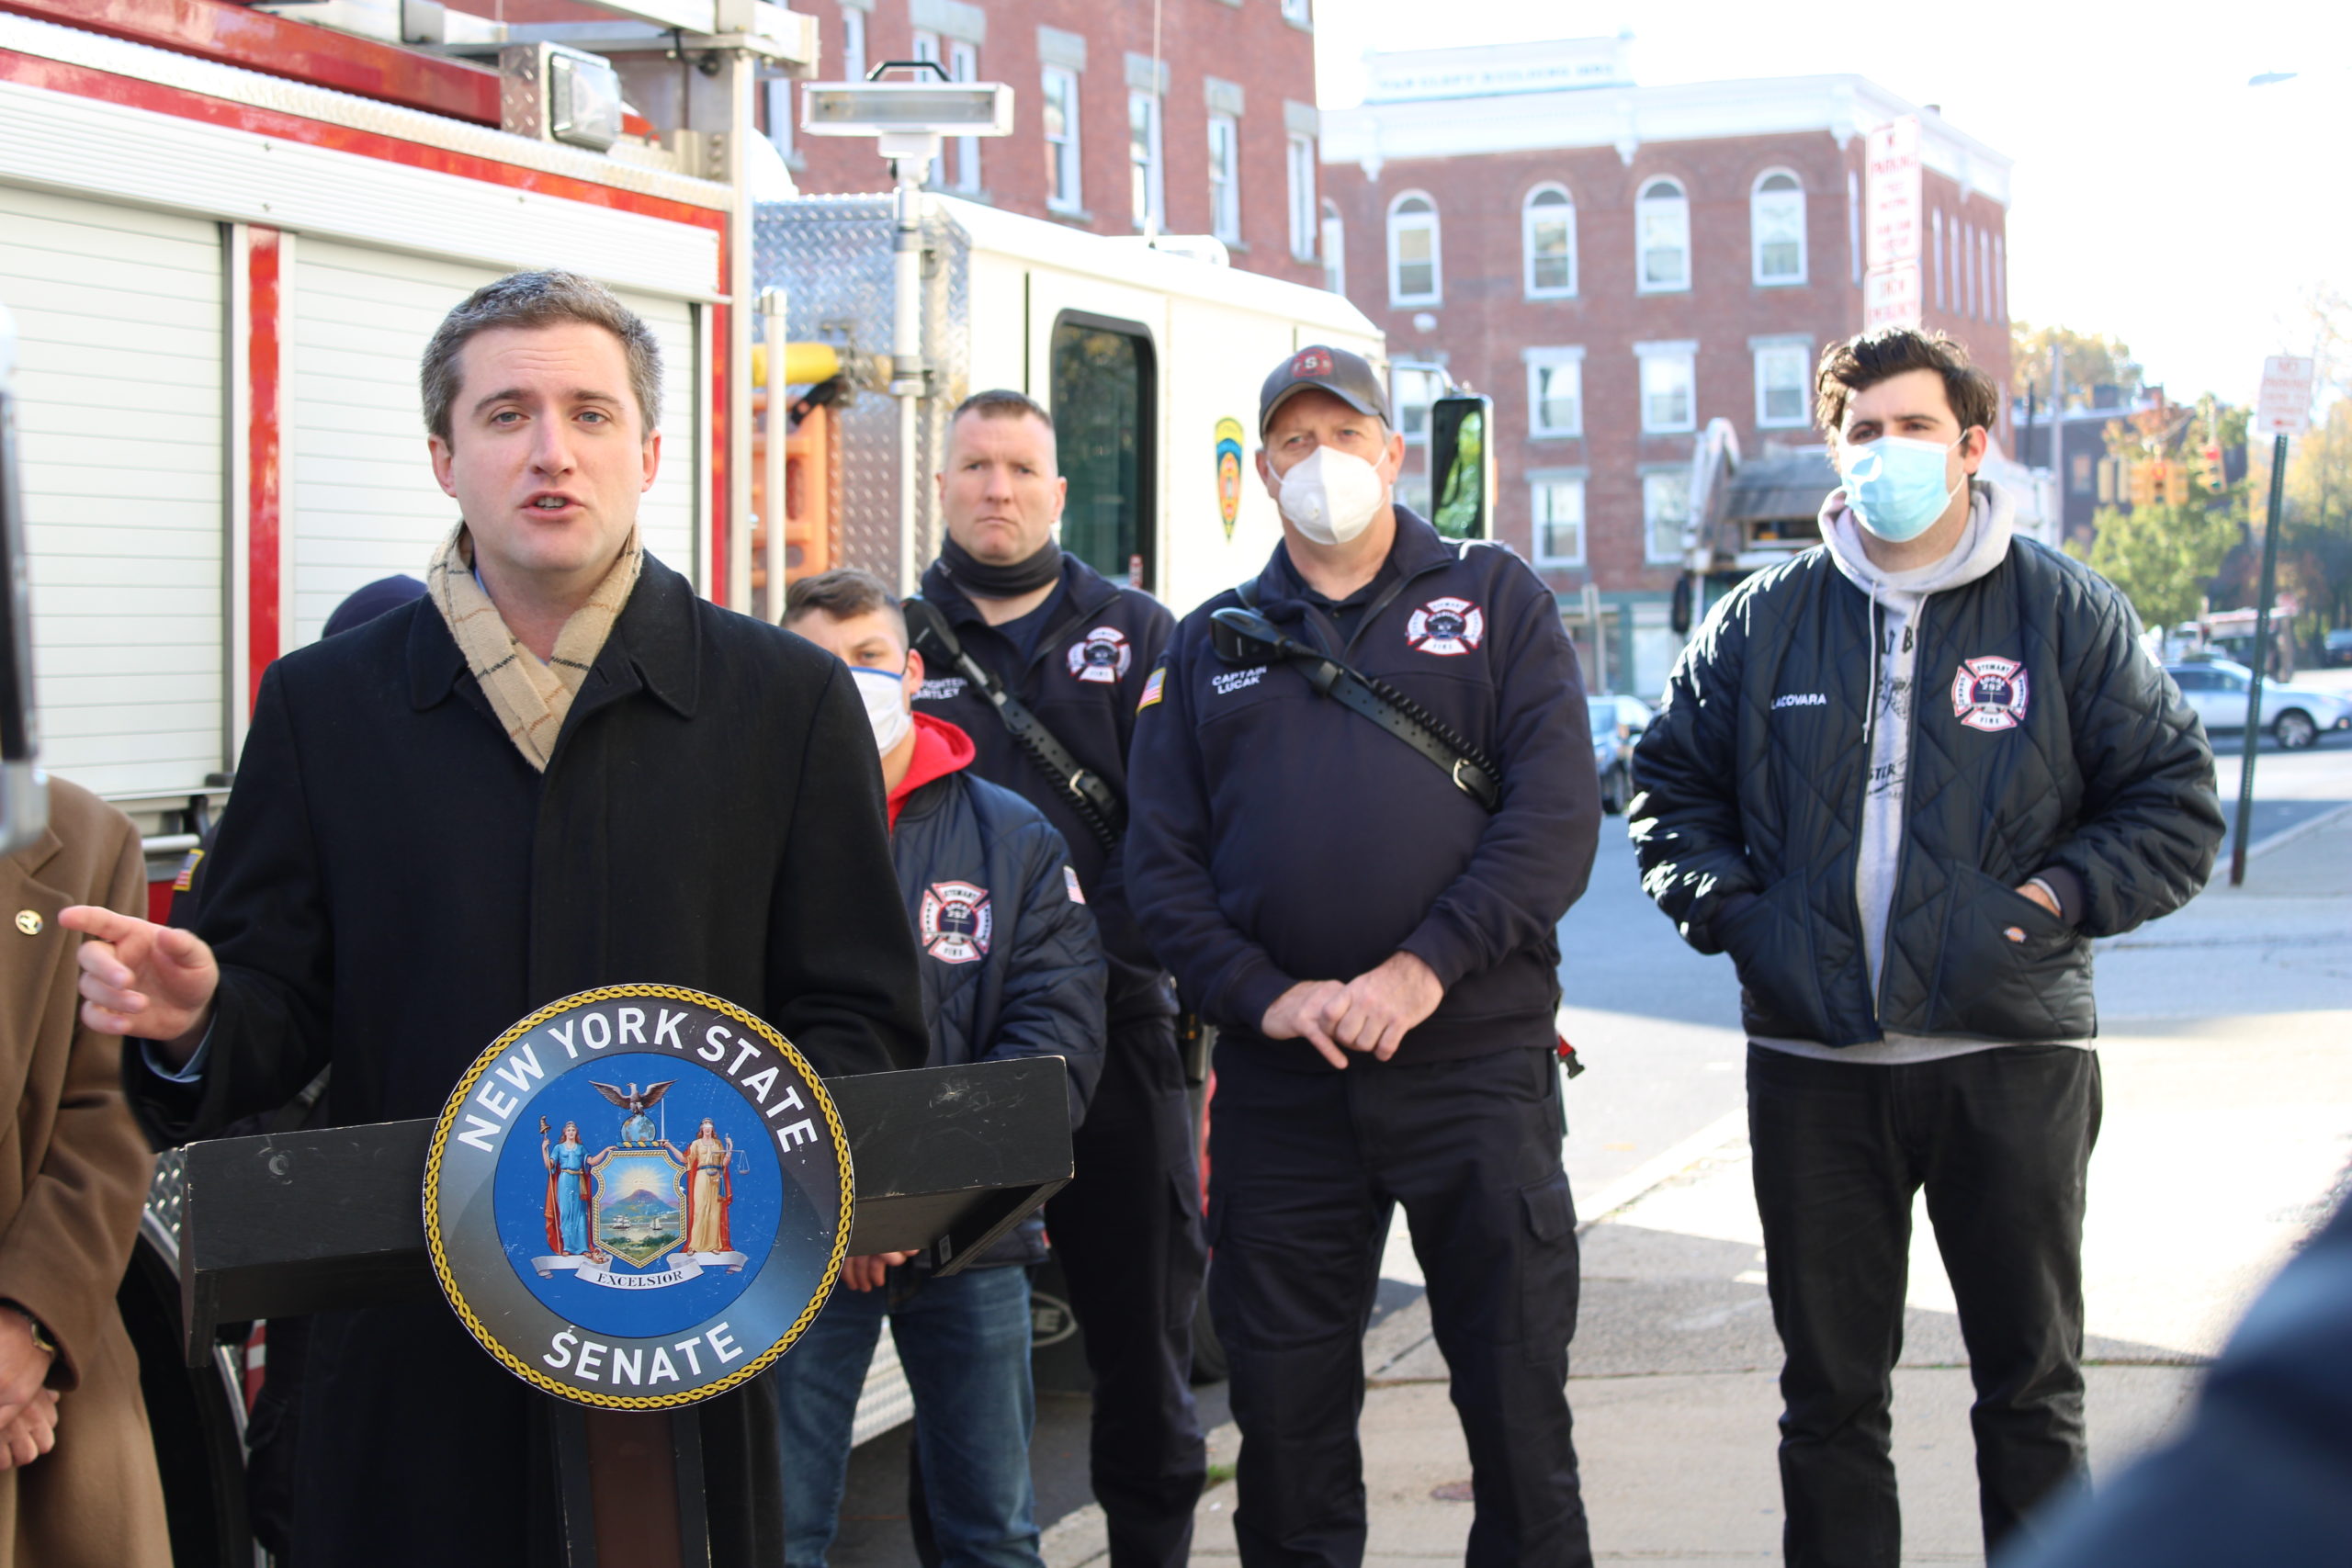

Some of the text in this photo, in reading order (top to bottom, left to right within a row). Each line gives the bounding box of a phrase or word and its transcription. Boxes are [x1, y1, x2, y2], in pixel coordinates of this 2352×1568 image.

[1212, 666, 1267, 686] CAPTAIN
[458, 1007, 820, 1153] NEW YORK STATE
[595, 1269, 684, 1288] EXCELSIOR
[542, 1321, 744, 1385] SENATE
